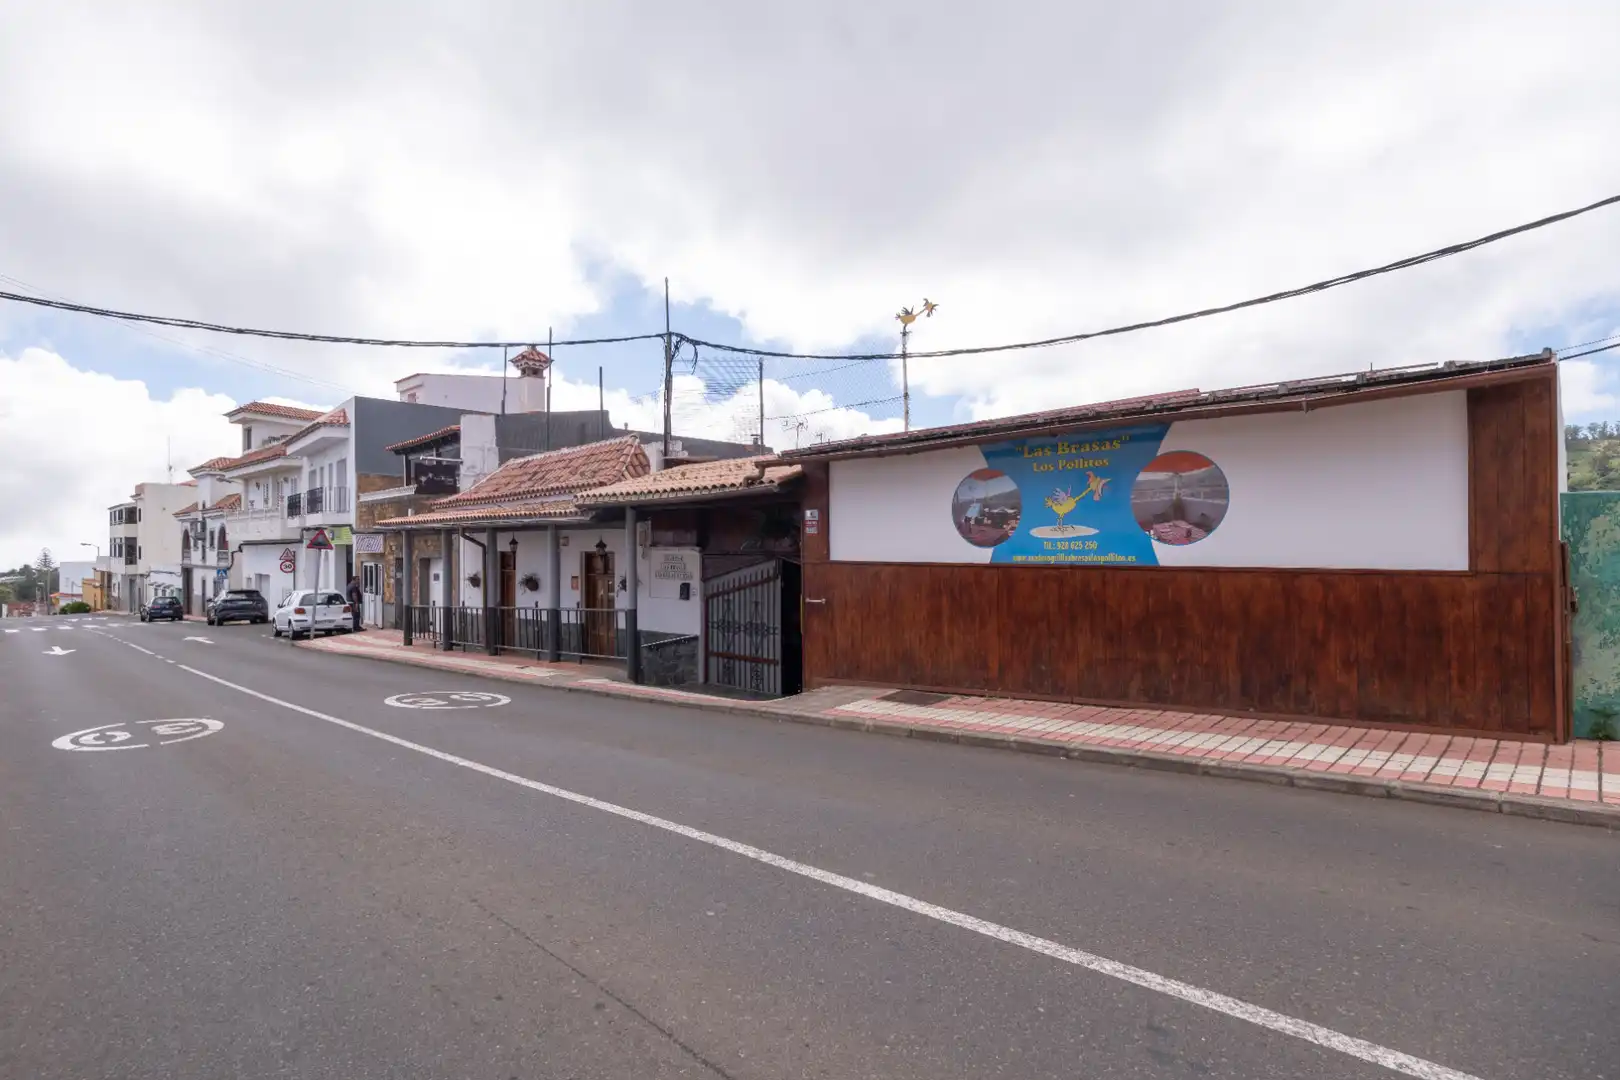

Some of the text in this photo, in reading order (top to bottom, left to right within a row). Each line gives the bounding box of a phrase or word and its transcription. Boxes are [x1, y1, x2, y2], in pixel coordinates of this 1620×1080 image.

[1057, 435, 1130, 455] Brasas"
[1033, 457, 1109, 472] Los Pollitos
[1057, 541, 1069, 550] 928
